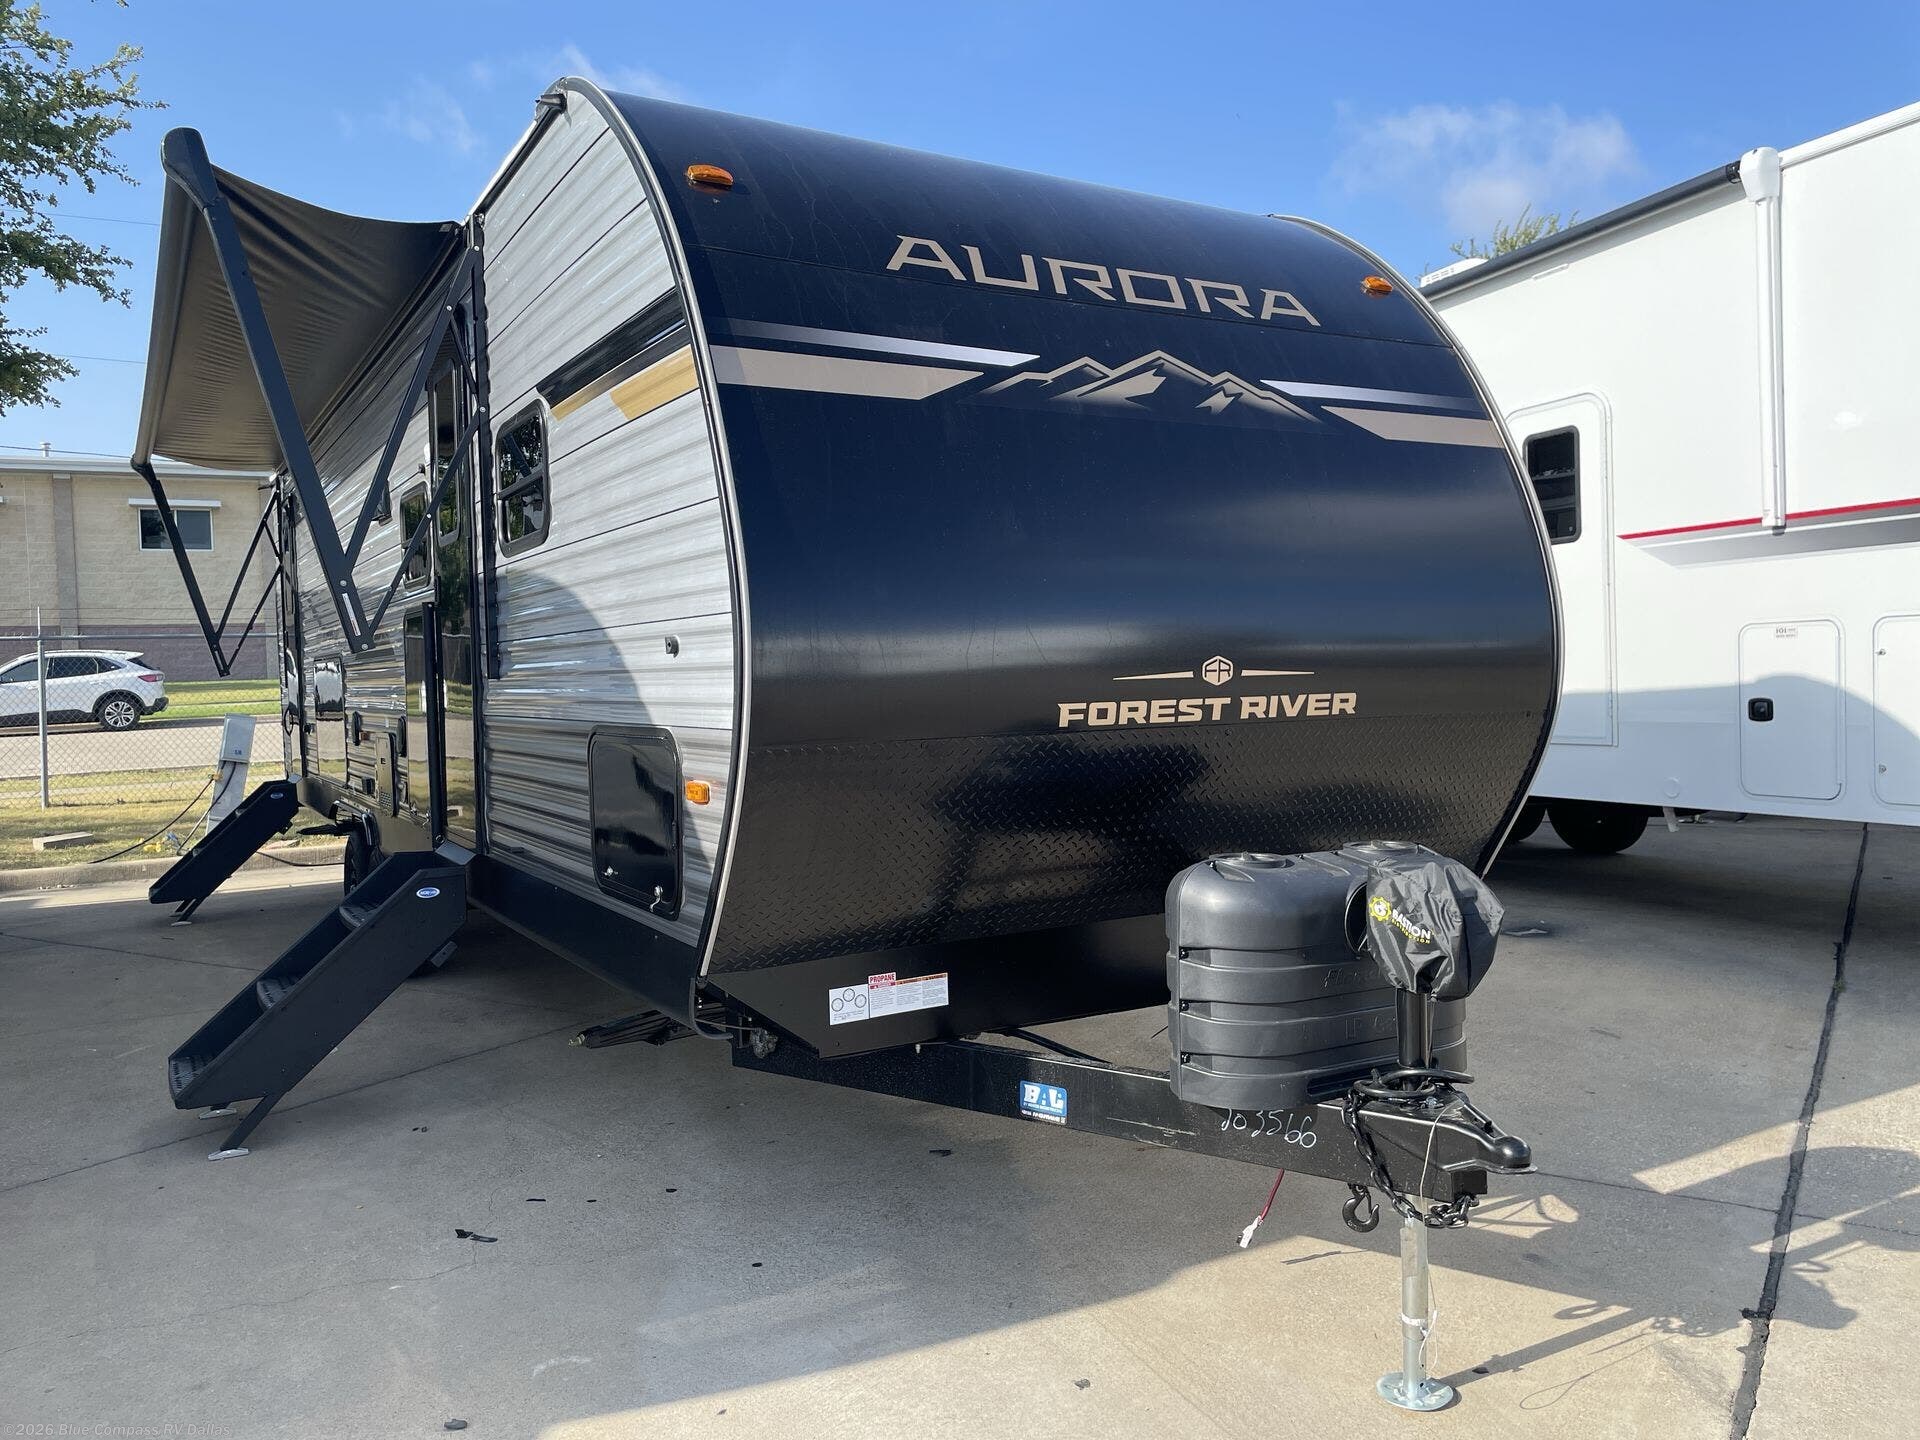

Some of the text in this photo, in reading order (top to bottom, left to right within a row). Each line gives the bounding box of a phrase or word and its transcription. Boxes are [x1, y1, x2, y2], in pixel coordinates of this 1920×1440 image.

[886, 235, 1321, 327] AURORA
[1058, 692, 1357, 727] FOREST RIVER
[1392, 909, 1431, 940] BASTION
[869, 974, 895, 983] PROPANE
